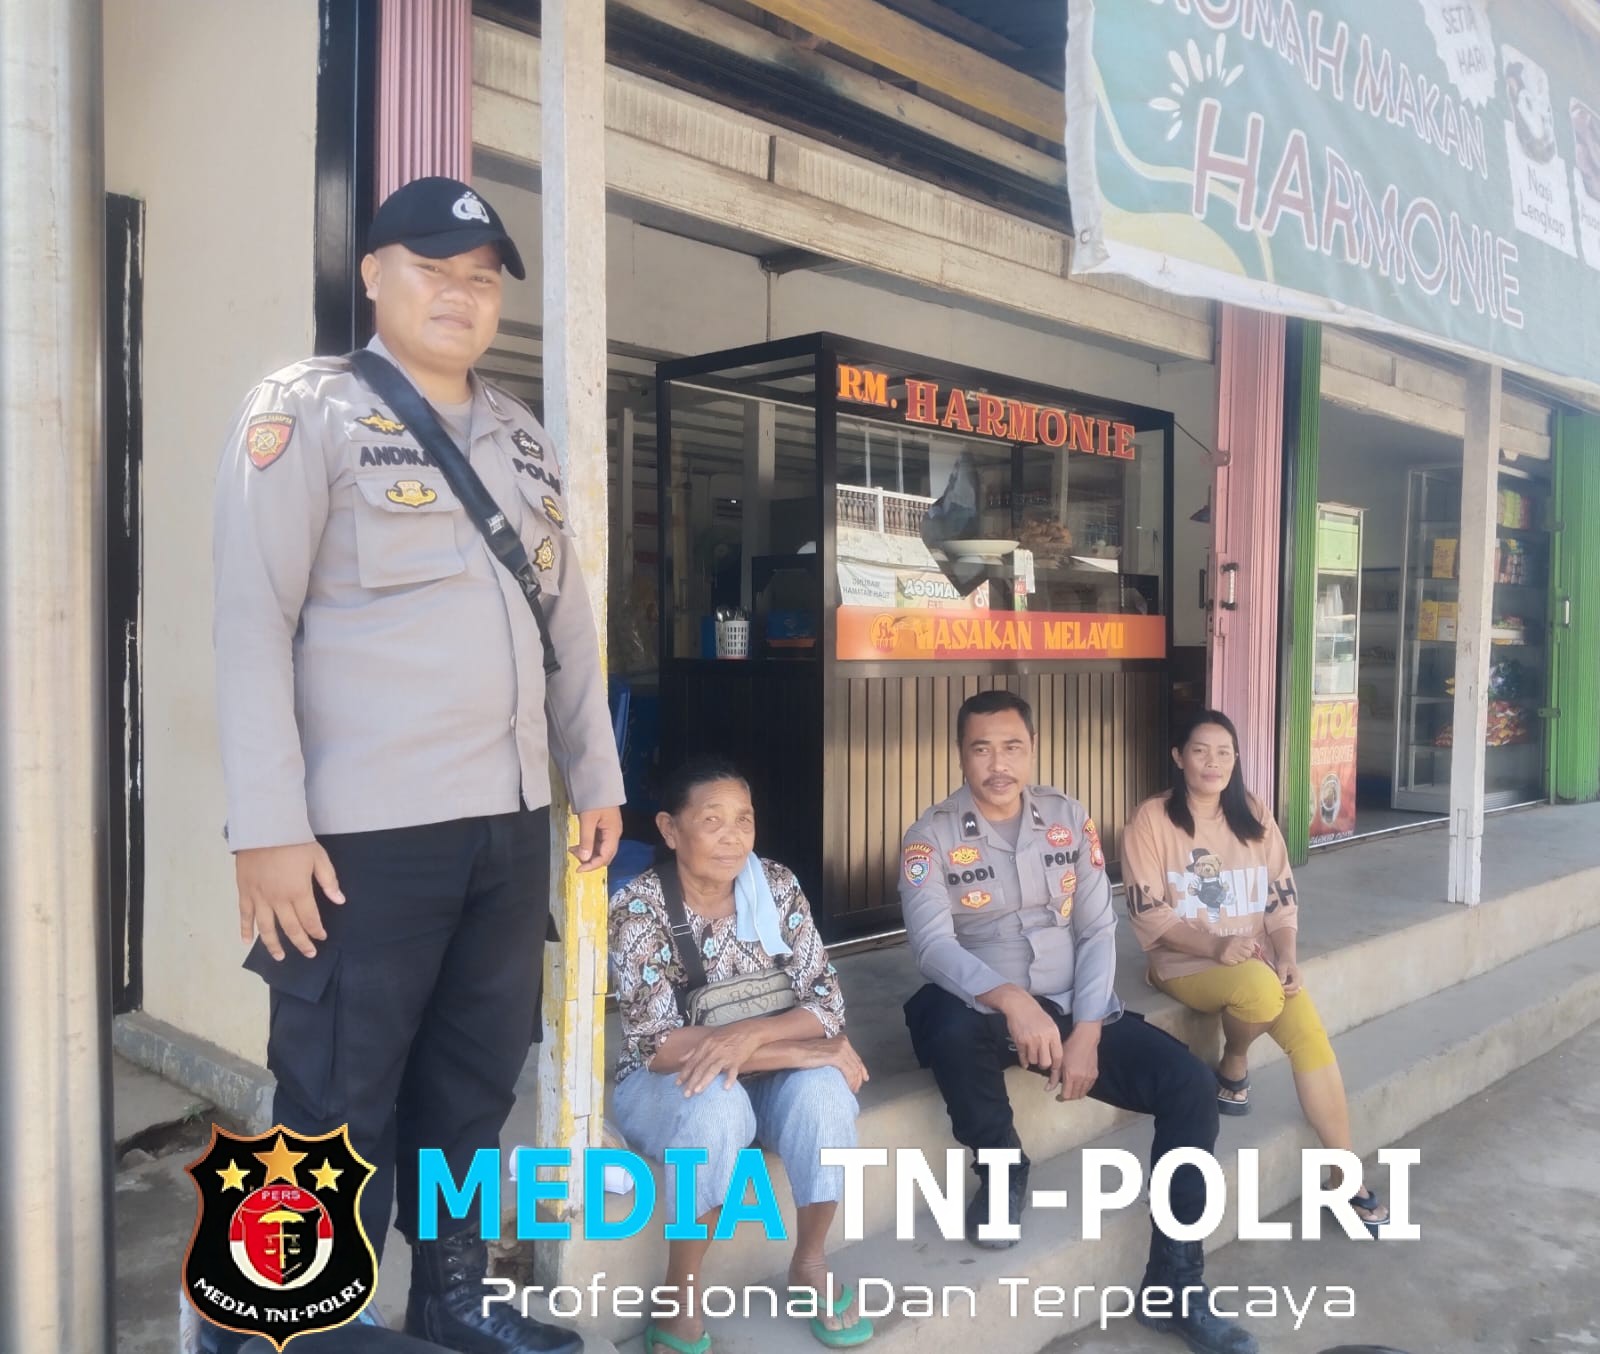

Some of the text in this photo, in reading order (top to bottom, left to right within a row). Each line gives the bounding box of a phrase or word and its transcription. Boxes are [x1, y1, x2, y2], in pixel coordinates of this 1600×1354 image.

[1354, 34, 1488, 180] MAKAN
[1193, 98, 1524, 329] HARMONIE
[837, 364, 1136, 461] RM. HARMONIE
[1044, 622, 1124, 650] MELAYU
[947, 865, 996, 886] DODI
